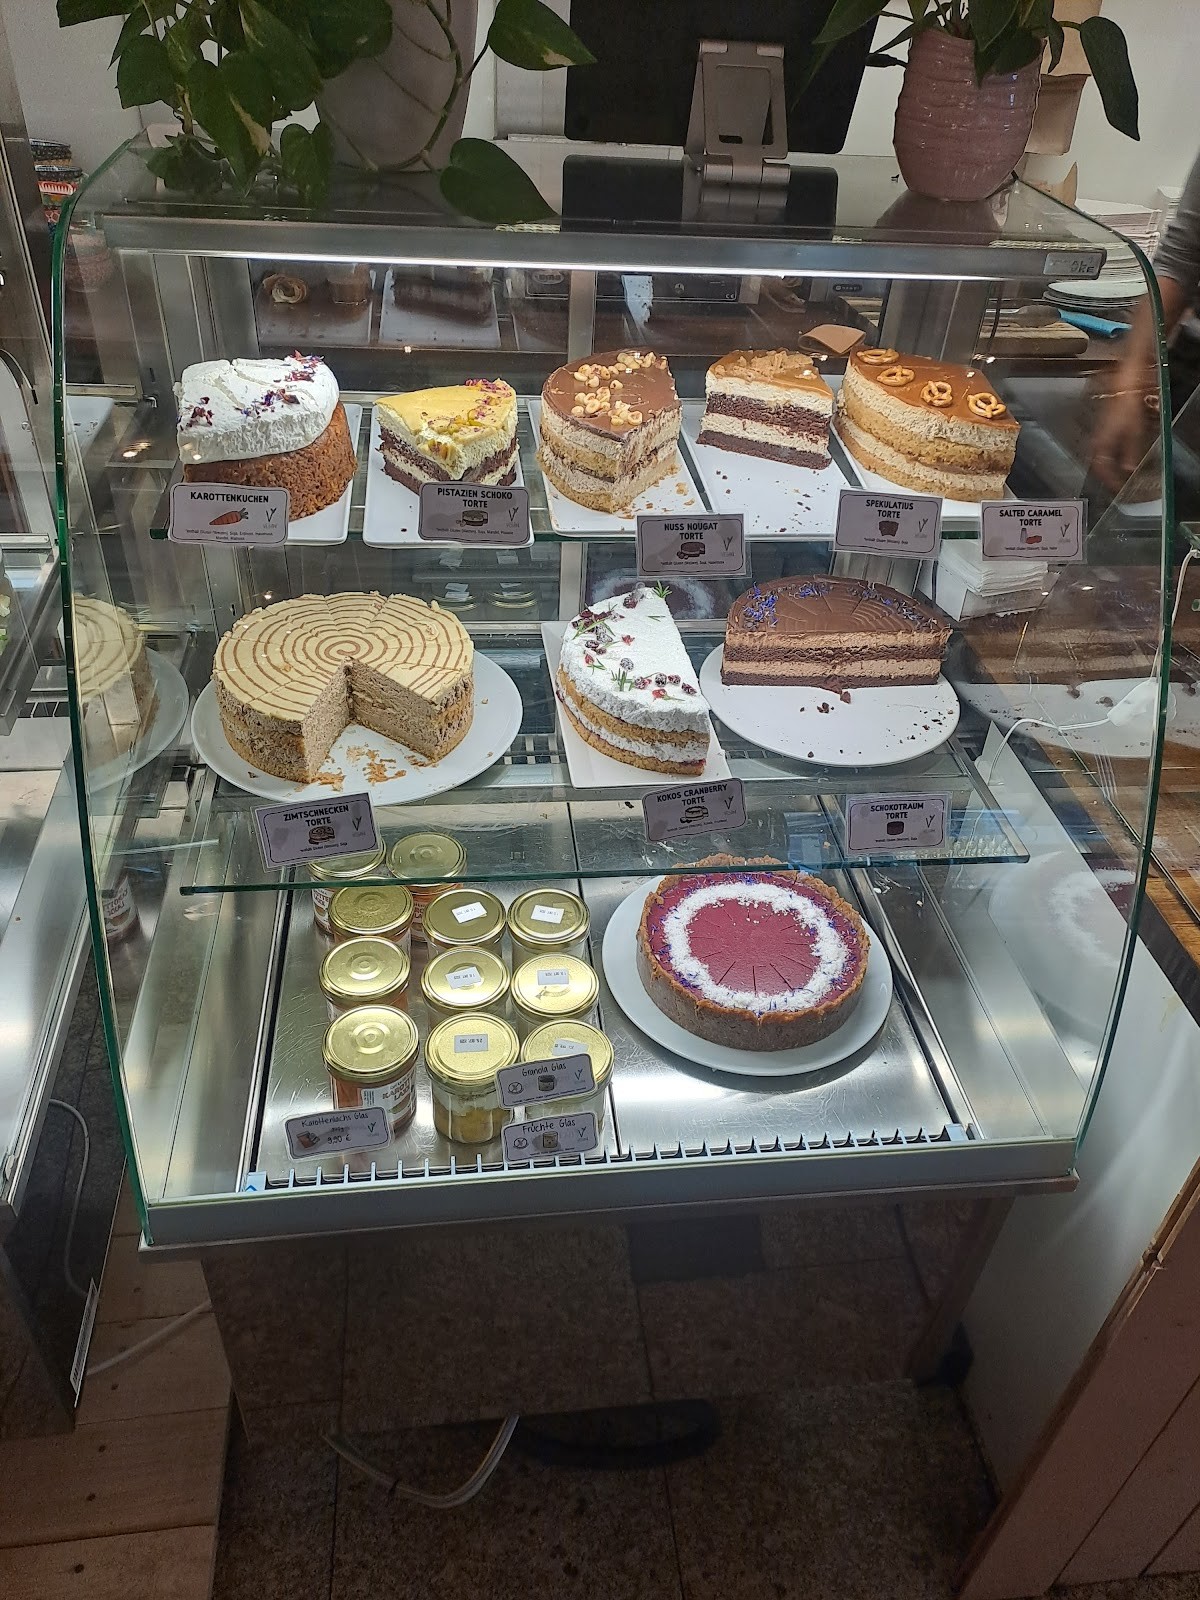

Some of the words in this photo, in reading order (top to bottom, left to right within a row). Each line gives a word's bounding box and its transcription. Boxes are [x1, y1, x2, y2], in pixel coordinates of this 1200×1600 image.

[190, 491, 269, 503] KAROTTENKUCHEN
[437, 487, 478, 498] PISTAZIEN
[480, 490, 513, 500] SCHOKO
[462, 499, 488, 508] TORTE
[865, 499, 914, 510] SPEKULATIUS
[877, 509, 901, 519] TORTE
[999, 509, 1026, 517] SALTED
[1027, 509, 1063, 517] CARAMEL
[664, 523, 685, 531] NUSS
[687, 522, 719, 531] NOUGAT
[1019, 518, 1042, 526] TORTE
[679, 532, 704, 541] TORTE
[656, 791, 682, 803] KOKOS
[683, 783, 728, 797] CRANBERRY
[682, 795, 706, 807] TORTE
[870, 802, 924, 812] SCHOKOTRAUM
[283, 804, 349, 822] ZIMTSCHNECKEN
[886, 811, 909, 820] TORTE
[305, 816, 332, 827] TORTE
[522, 1066, 548, 1077] Granola
[551, 1062, 567, 1071] Glas
[354, 1112, 369, 1120] Glas
[522, 1121, 554, 1135] Früchte
[559, 1118, 576, 1128] Glas
